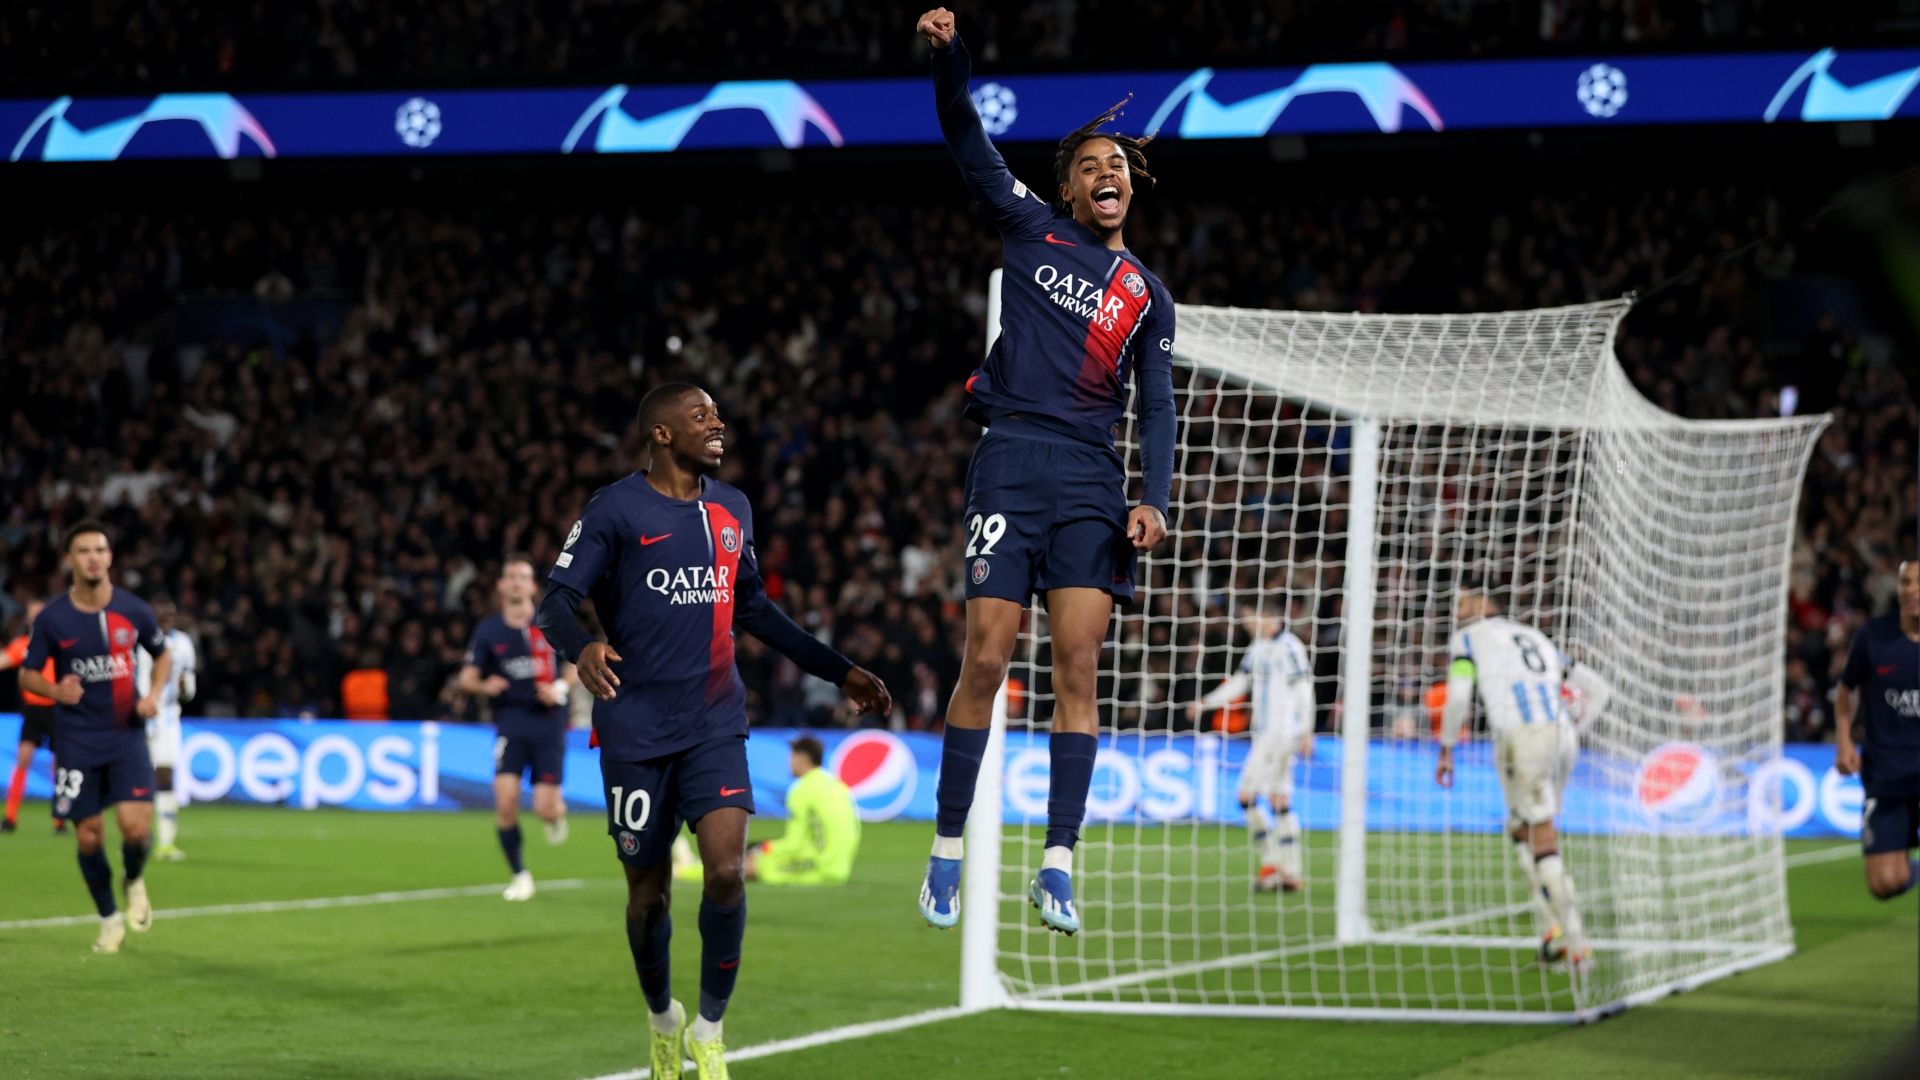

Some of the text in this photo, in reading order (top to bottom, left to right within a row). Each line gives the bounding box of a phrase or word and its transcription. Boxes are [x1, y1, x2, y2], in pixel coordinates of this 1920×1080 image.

[1034, 264, 1124, 320] QATAR
[1050, 291, 1116, 332] AIRWAYS
[965, 513, 1007, 558] 29
[646, 565, 730, 595] QATAR
[670, 588, 730, 605] AIRWAYS
[1513, 634, 1546, 673] 8
[173, 720, 440, 811] pepsi
[1005, 734, 1220, 820] epsi
[611, 786, 651, 832] 10
